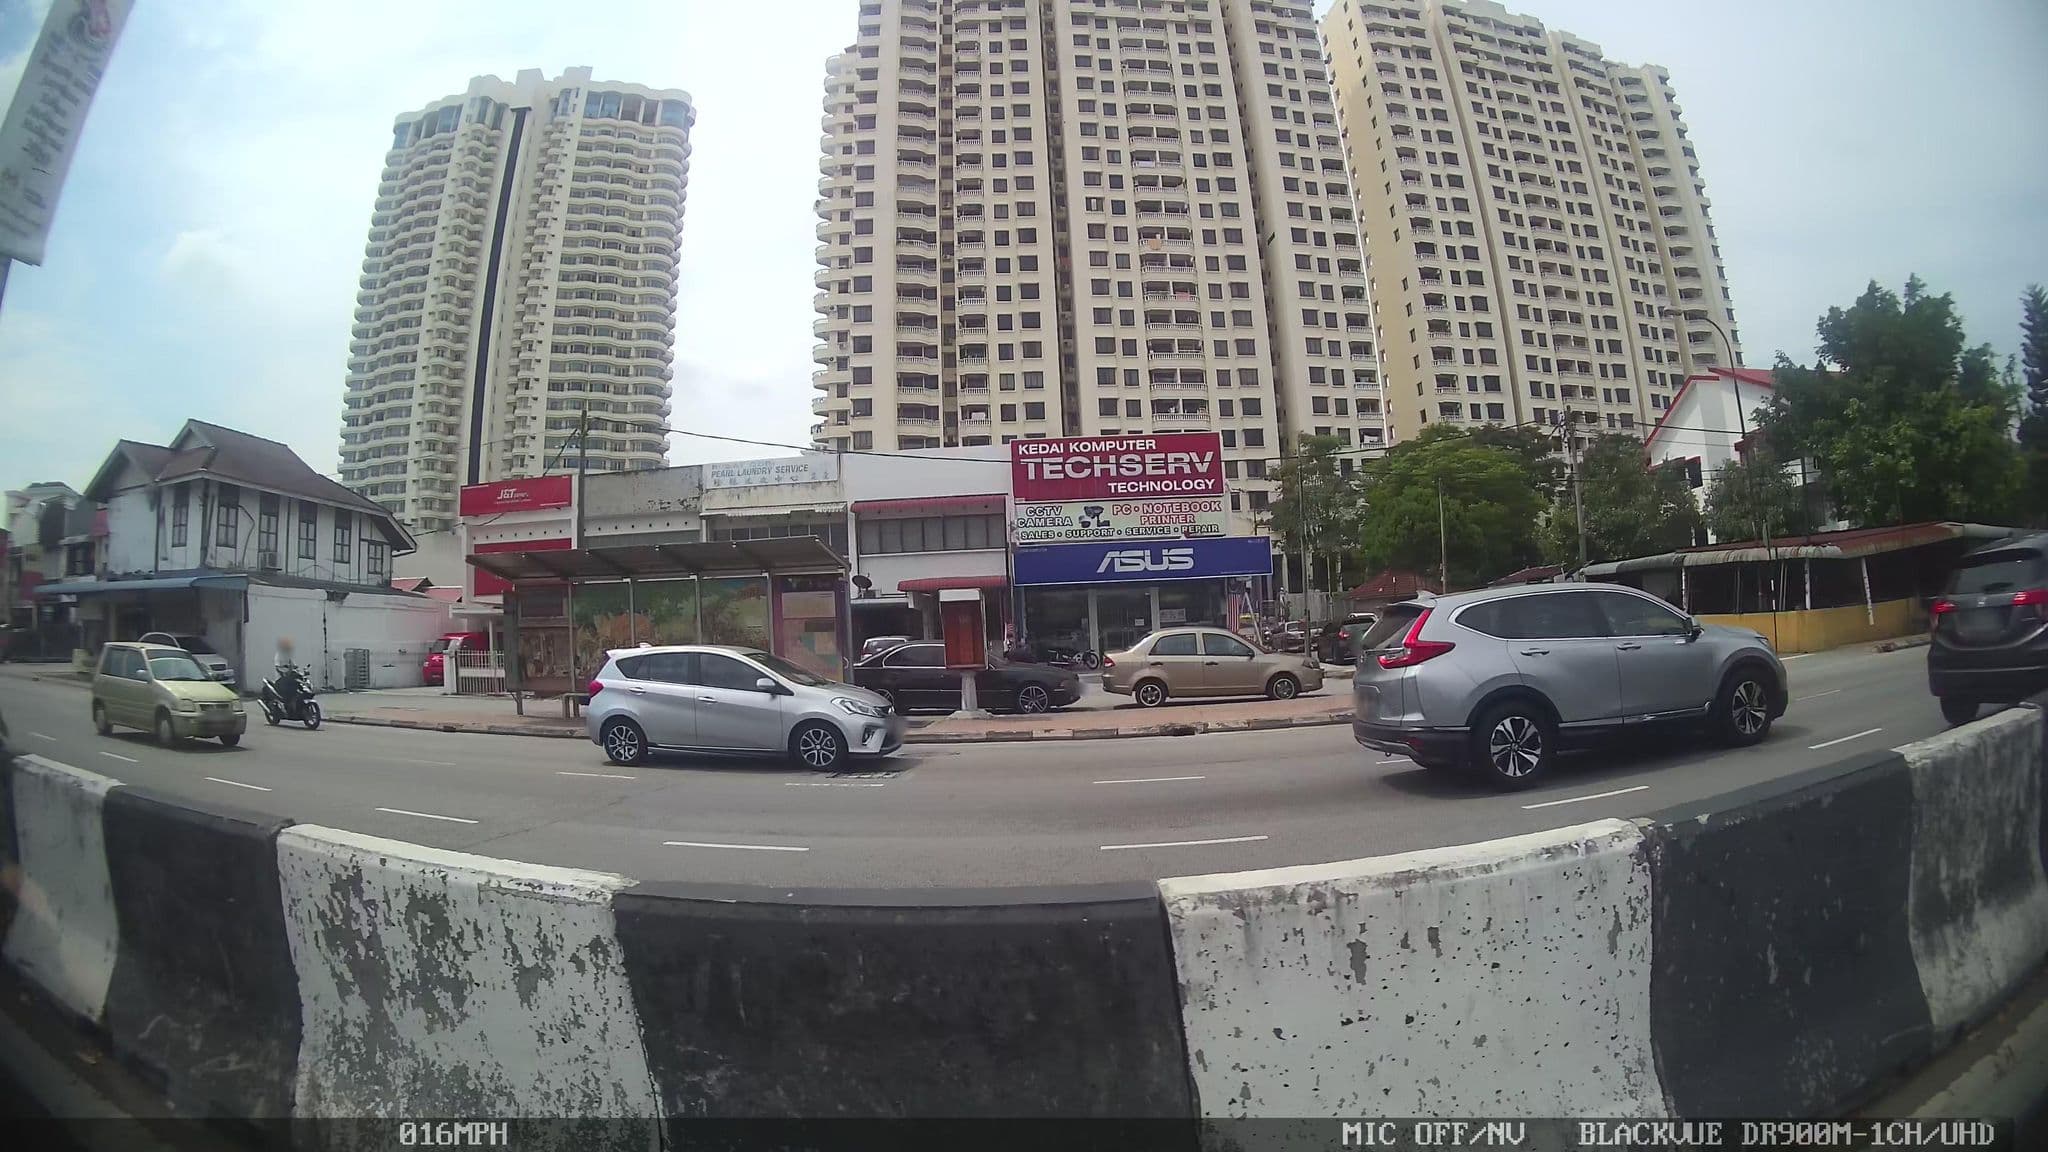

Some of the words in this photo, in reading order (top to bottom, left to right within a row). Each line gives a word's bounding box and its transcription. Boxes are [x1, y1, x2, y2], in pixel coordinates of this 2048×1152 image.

[1018, 443, 1064, 455] KEDAI
[1069, 439, 1157, 453] KOMPUTER
[737, 466, 772, 477] LAUNDRY
[775, 463, 809, 474] SERVICE
[1019, 451, 1214, 480] TECHSERV
[1108, 478, 1216, 494] TECHNOLOGY
[1026, 505, 1063, 517] CCTV
[1112, 503, 1132, 516] PC
[1142, 500, 1222, 515] NOTEBOOK
[1016, 516, 1073, 529] CAMERA
[1140, 514, 1197, 526] PRINTER
[1020, 530, 1056, 540] SALES
[1065, 527, 1115, 539] SUPPORT
[1125, 525, 1171, 536] SERVICE
[1181, 523, 1220, 535] REPAIR
[1096, 547, 1194, 574] ASUS
